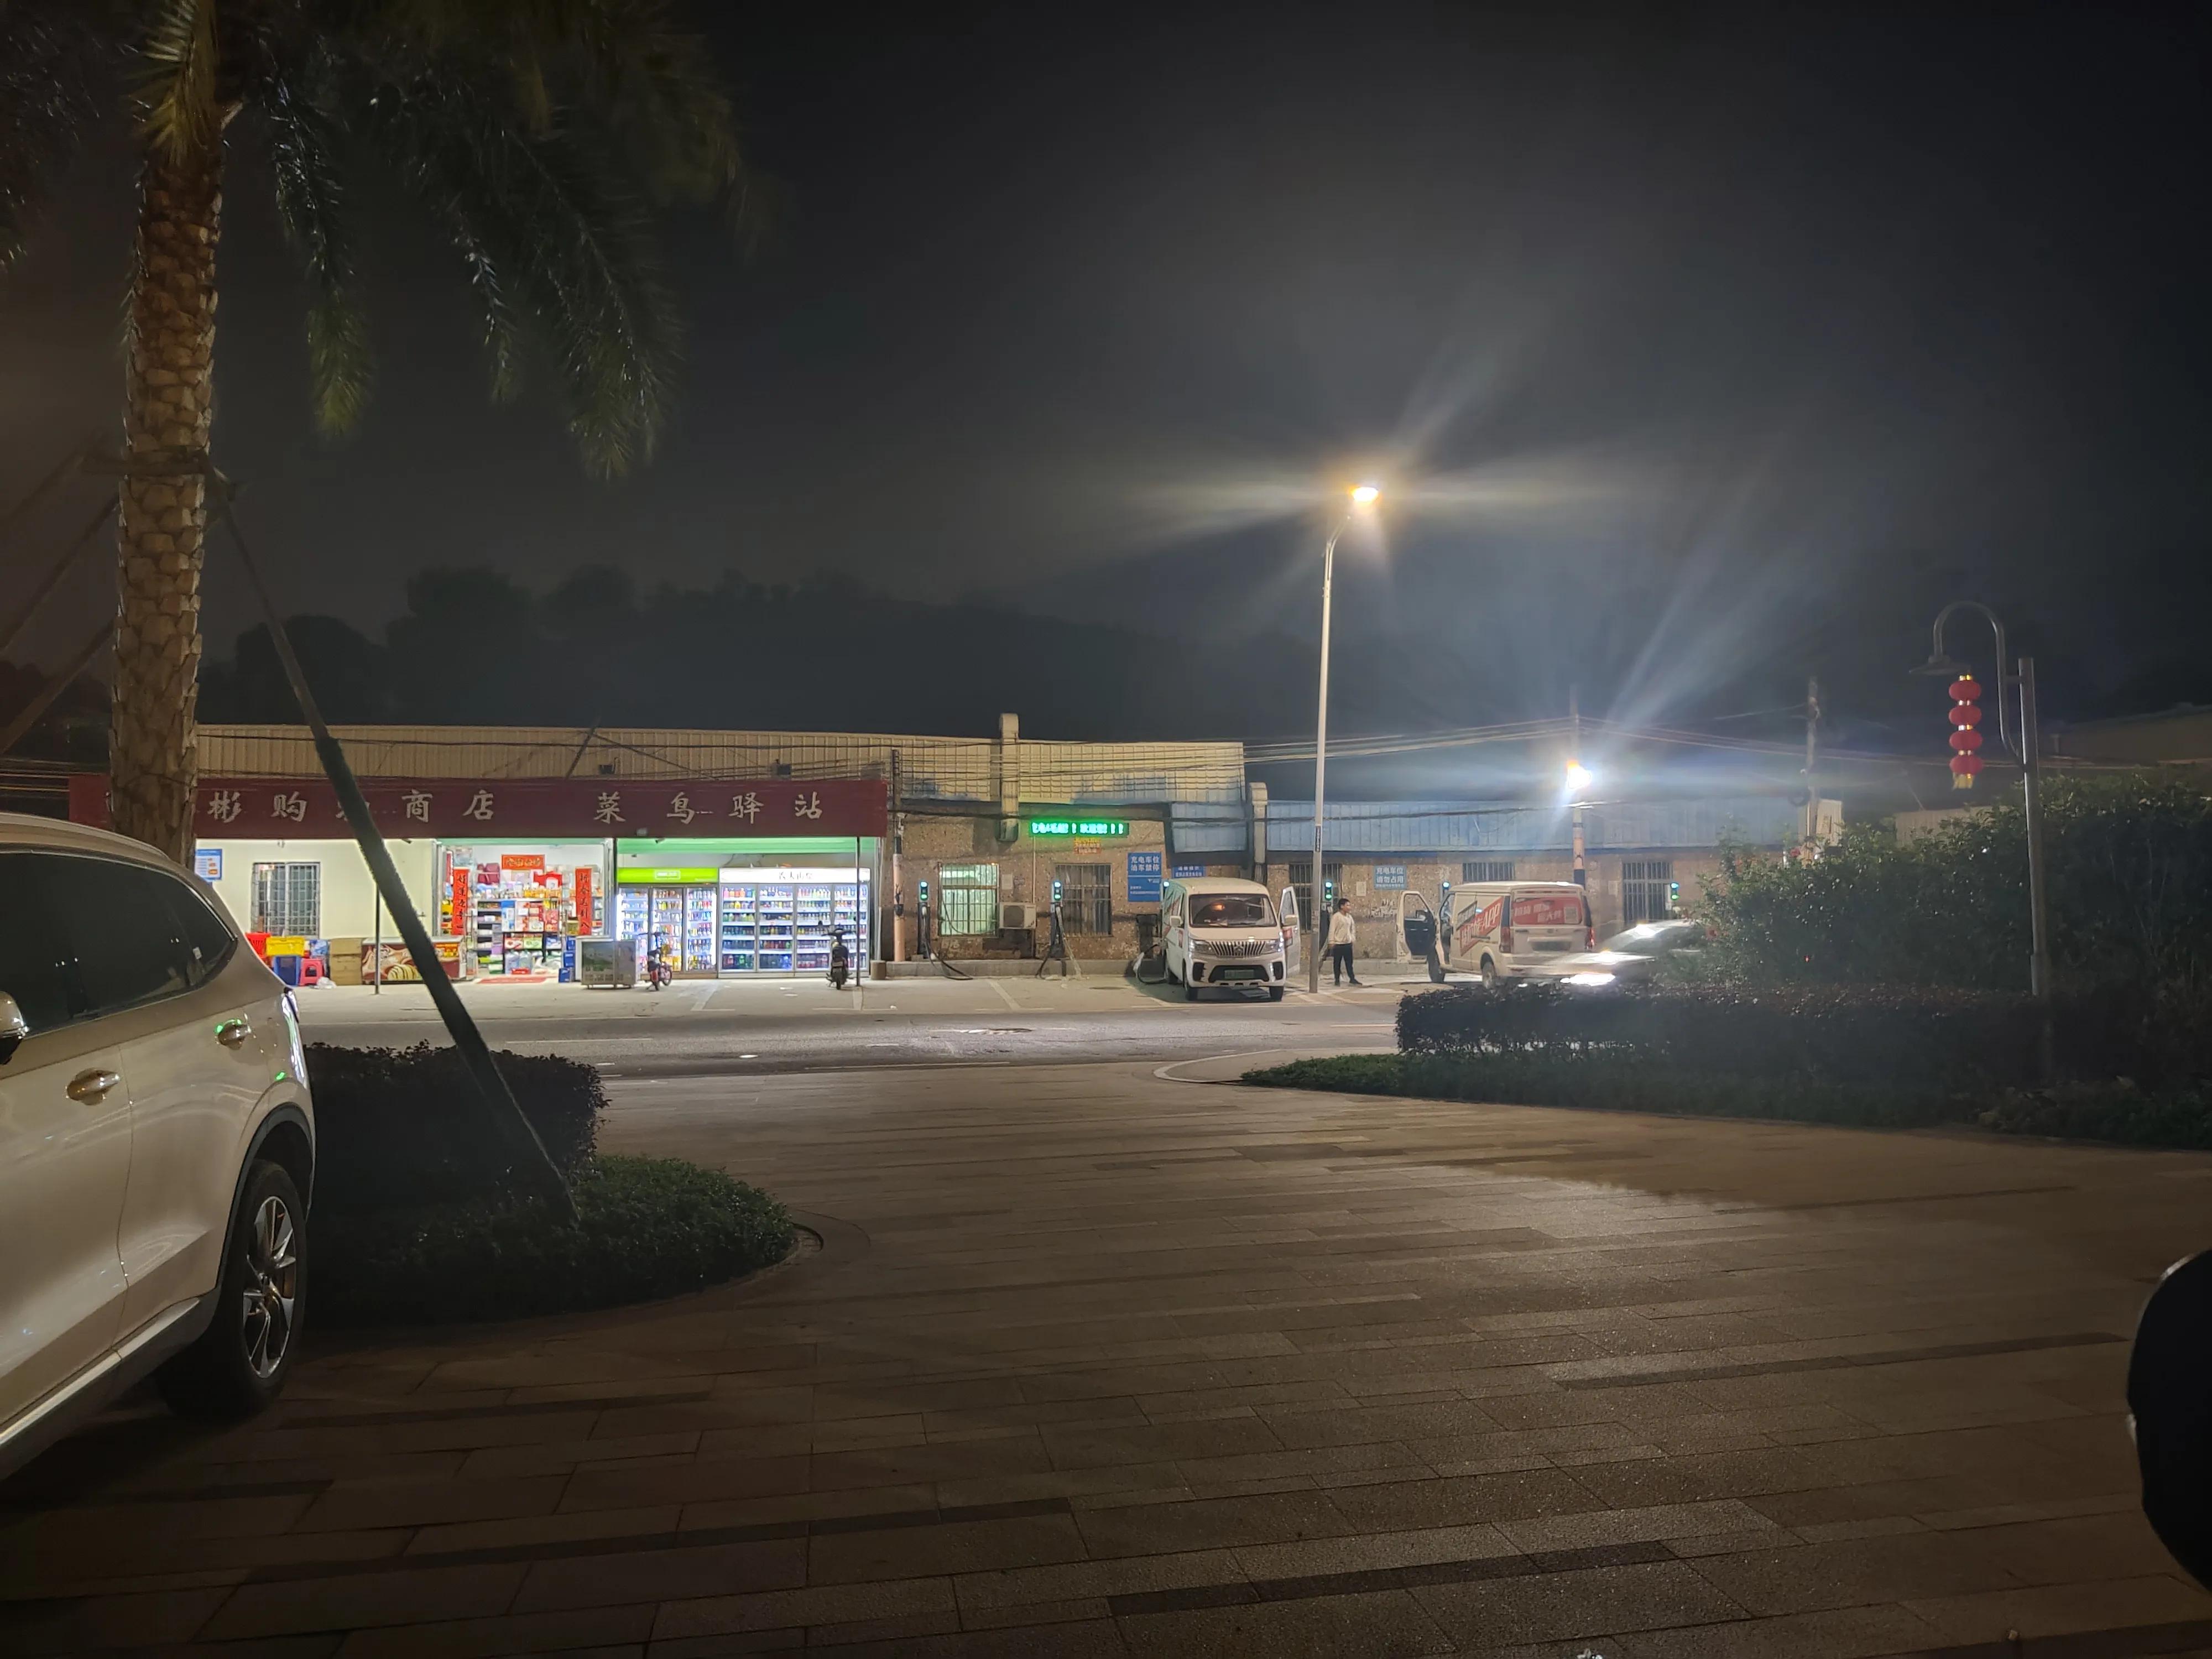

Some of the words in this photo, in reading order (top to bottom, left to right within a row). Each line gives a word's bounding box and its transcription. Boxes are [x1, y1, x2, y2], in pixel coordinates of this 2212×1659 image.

[105, 789, 494, 822] 彬购商店
[594, 791, 823, 824] 菜鸟驿站
